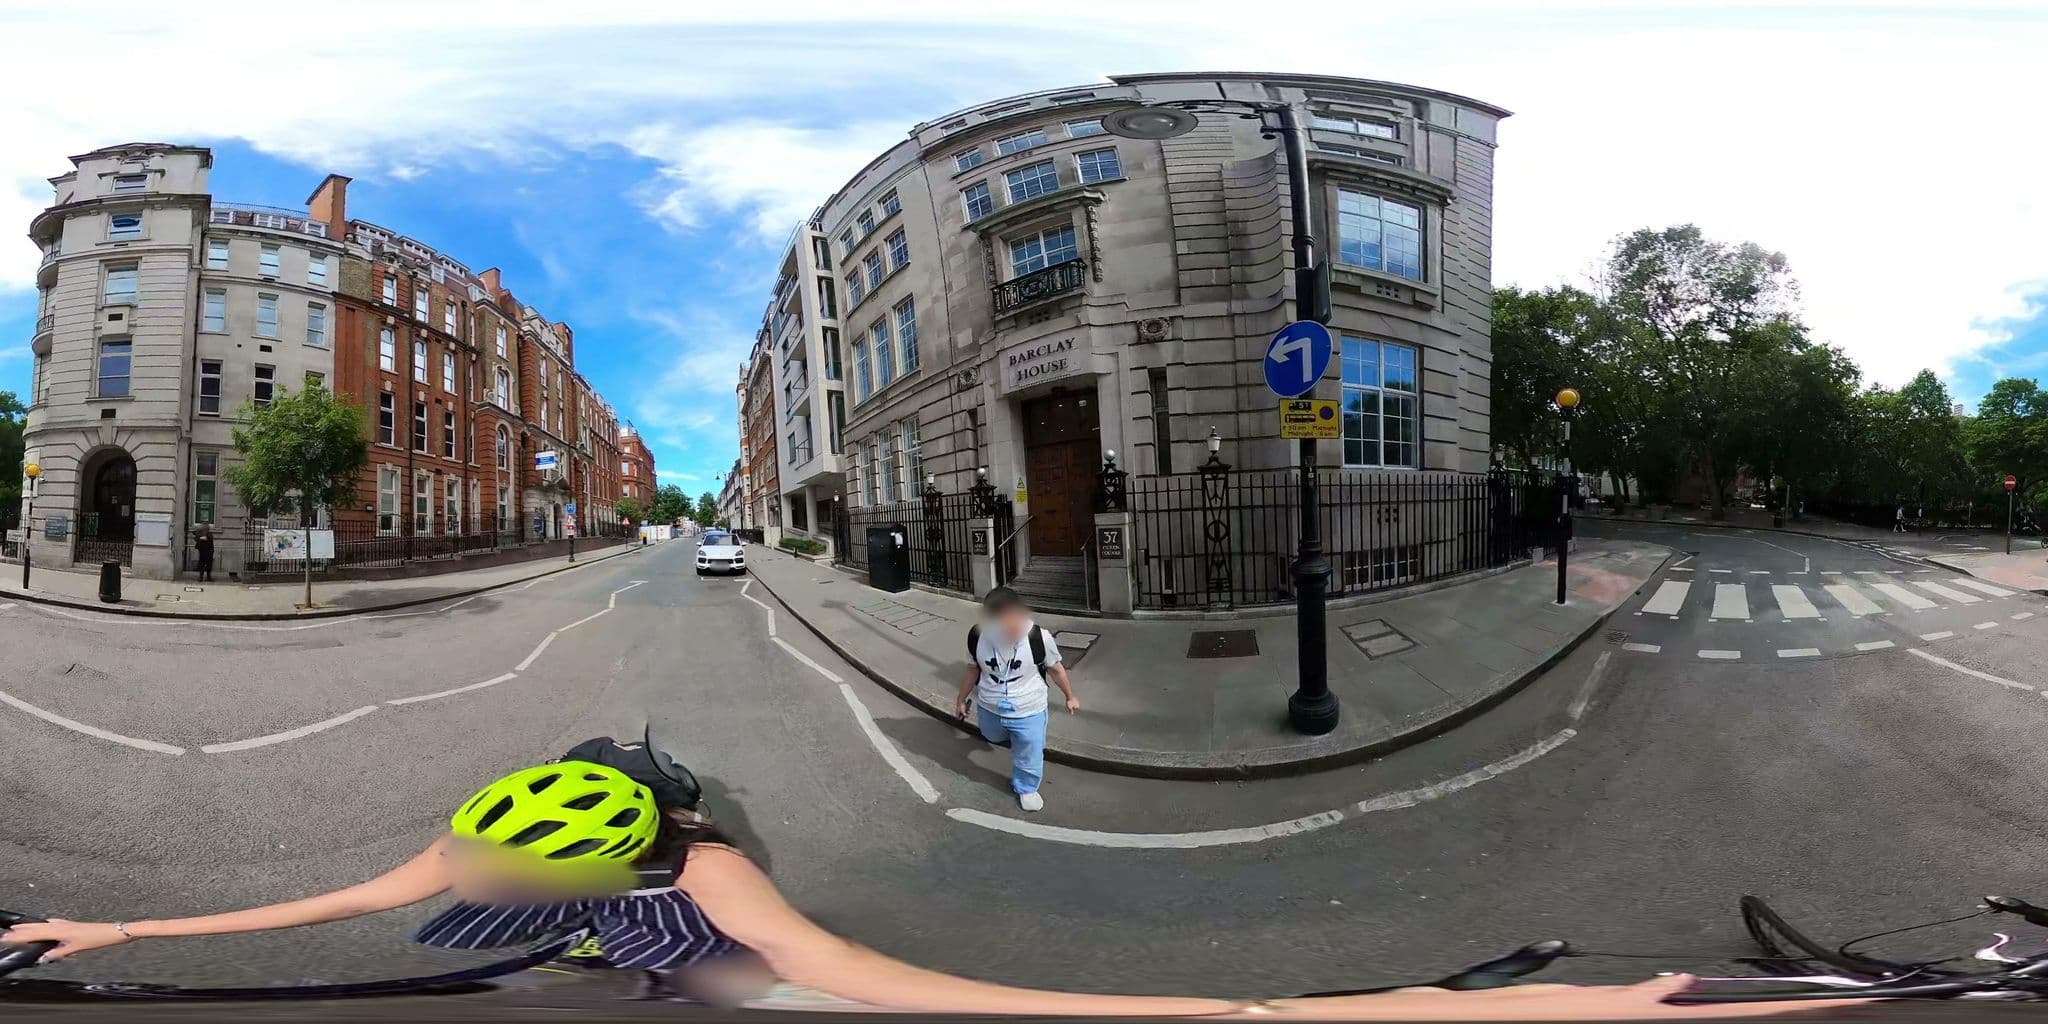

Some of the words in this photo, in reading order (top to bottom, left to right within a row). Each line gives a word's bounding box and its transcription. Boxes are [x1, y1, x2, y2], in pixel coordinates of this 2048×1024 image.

[1009, 337, 1075, 366] BARCLAY
[1017, 358, 1069, 381] HOUSE
[1103, 531, 1118, 544] 37
